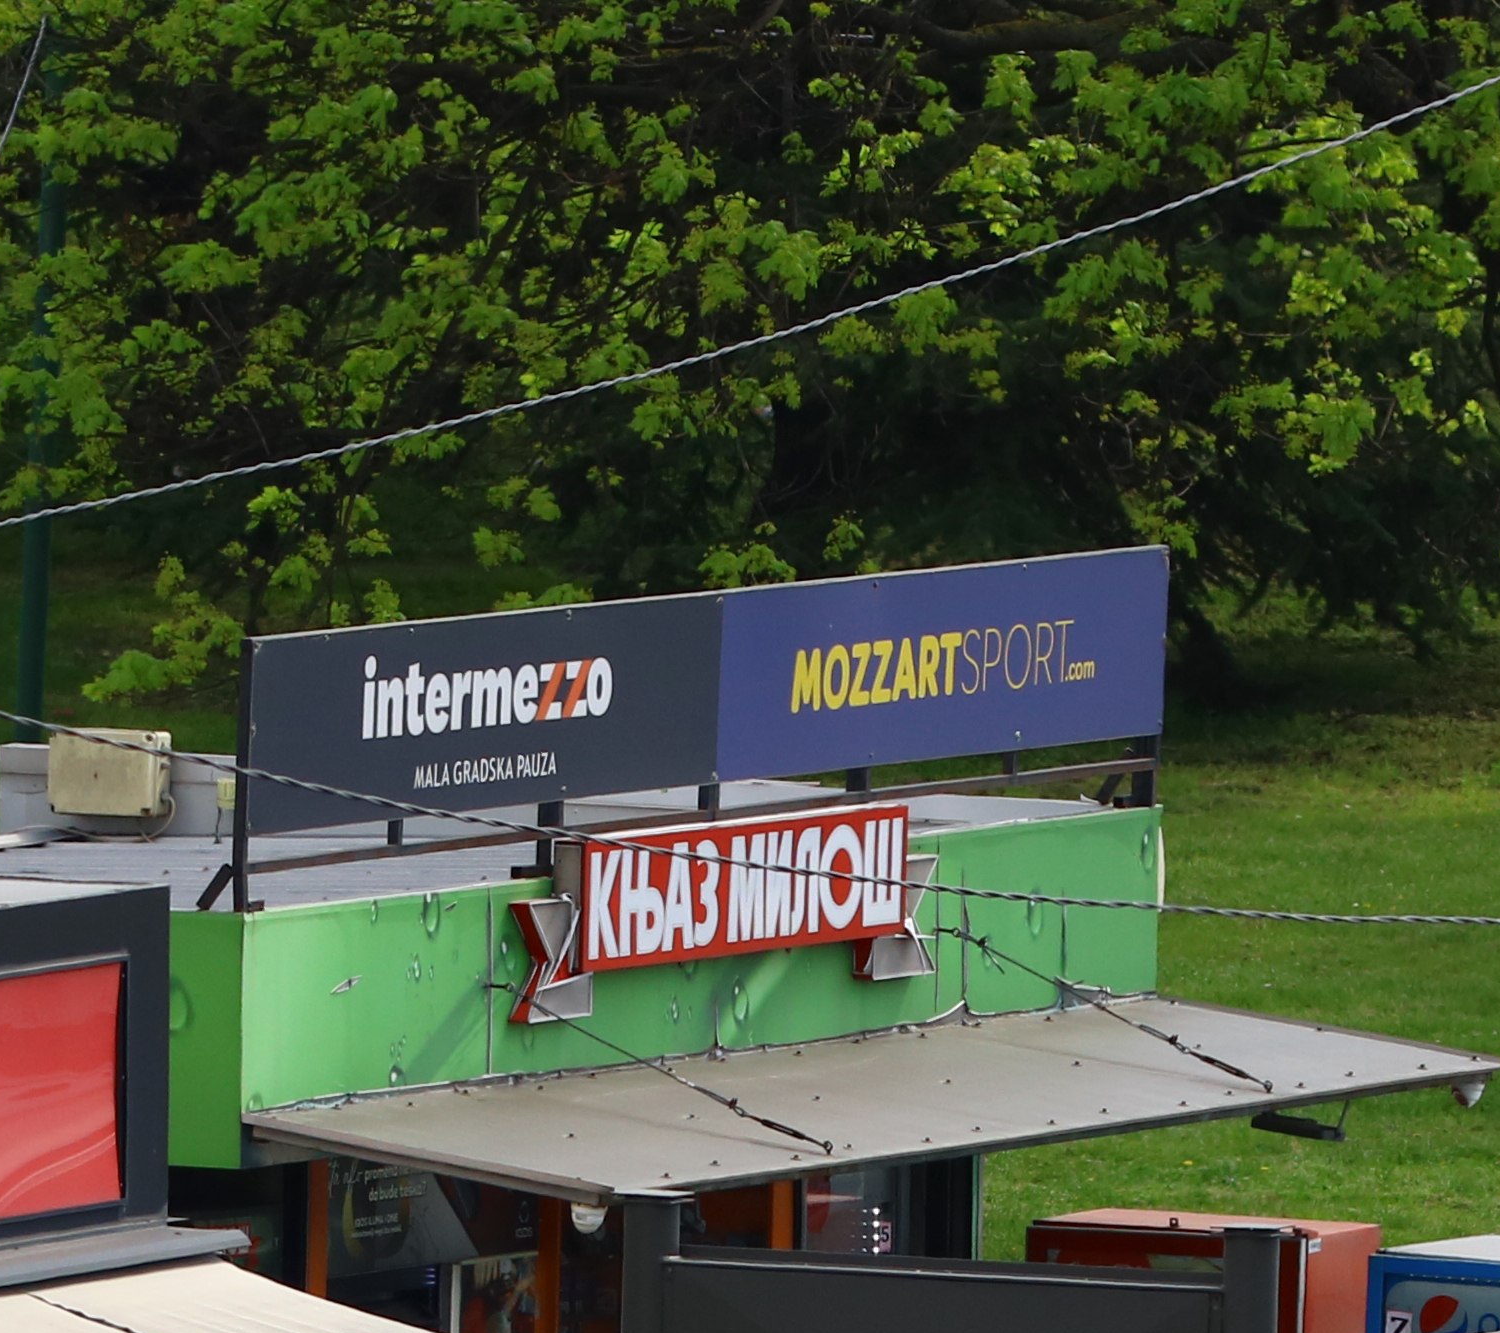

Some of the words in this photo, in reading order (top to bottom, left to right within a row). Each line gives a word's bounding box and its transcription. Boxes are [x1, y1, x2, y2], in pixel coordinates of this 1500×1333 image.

[362, 655, 613, 740] intermezzo
[414, 763, 450, 789] MALA
[453, 756, 513, 785] GRADSKA
[516, 751, 557, 777] PAUZA
[588, 839, 720, 960] КЊАЗ
[727, 817, 904, 943] МИЛОШ
